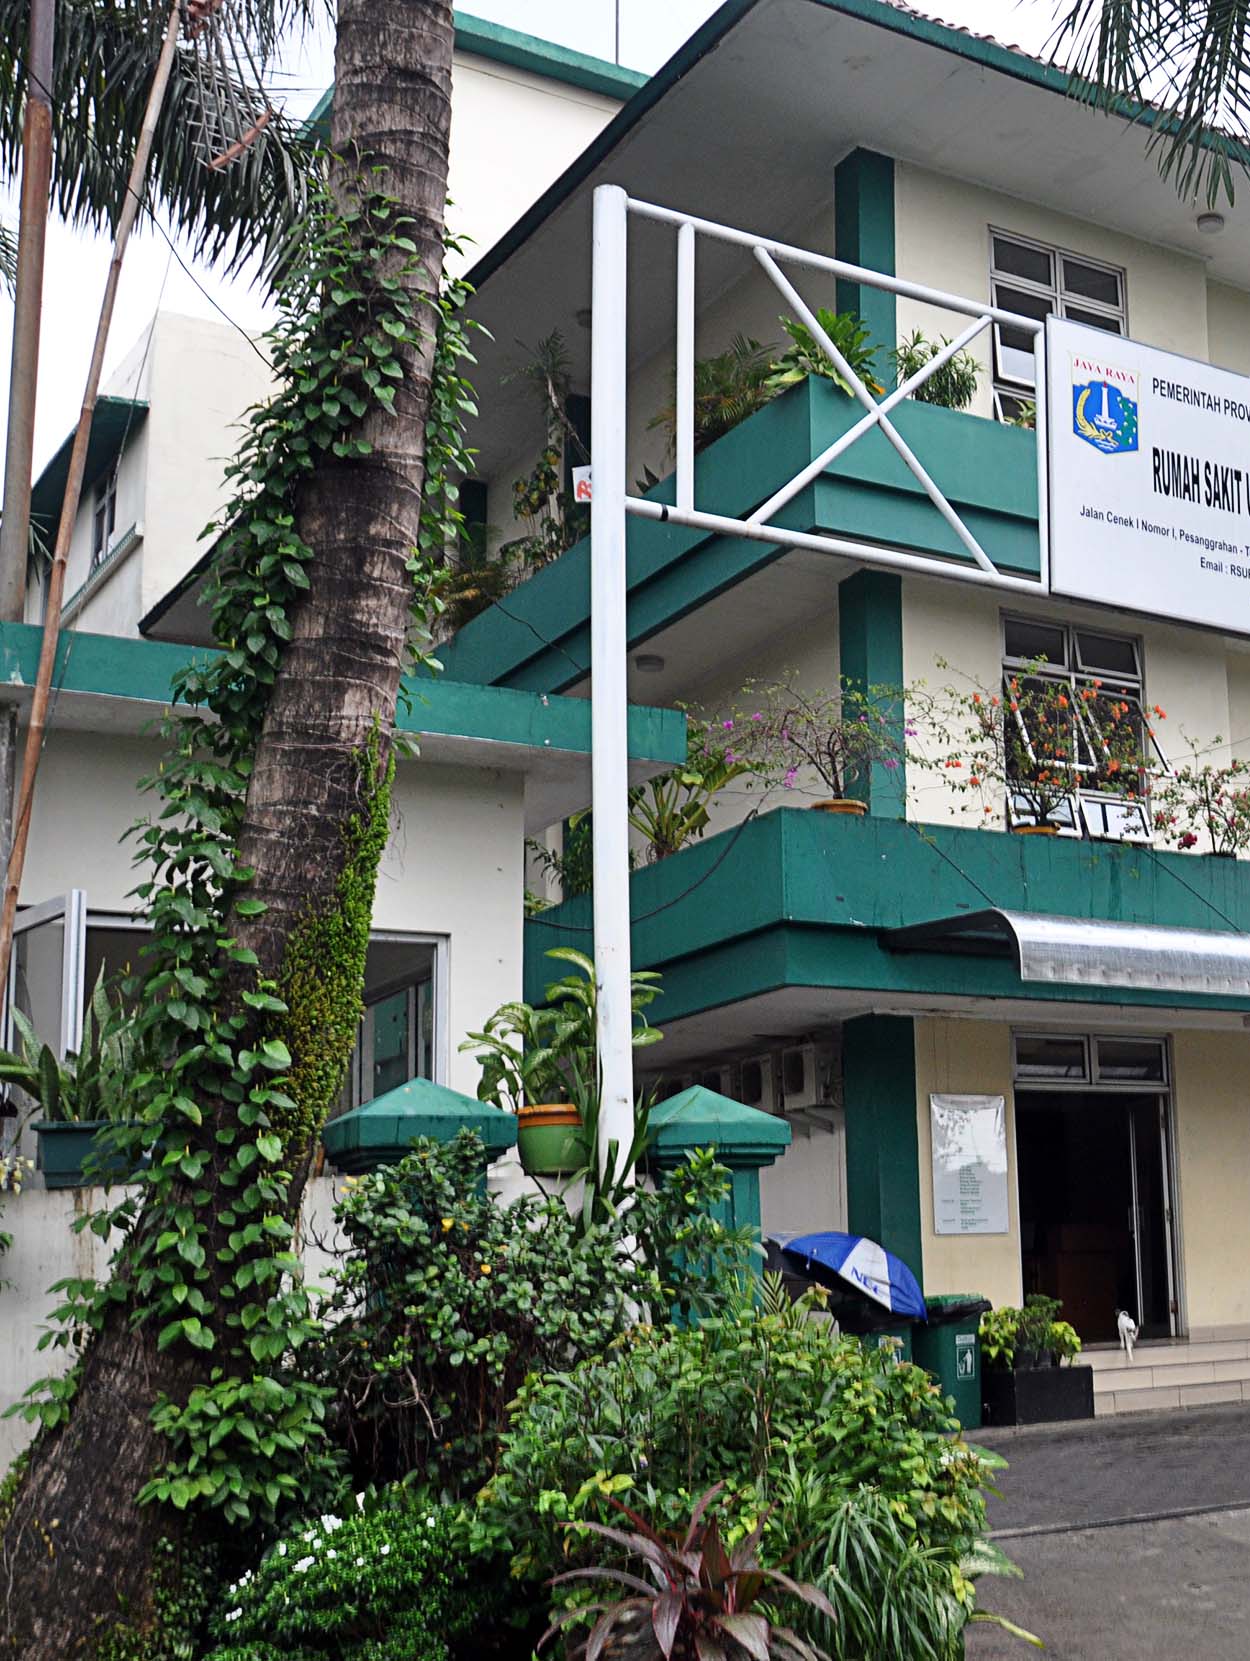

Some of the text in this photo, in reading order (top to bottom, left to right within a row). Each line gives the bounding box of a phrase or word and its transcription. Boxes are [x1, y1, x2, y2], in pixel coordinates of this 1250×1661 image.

[1073, 358, 1135, 384] JAYA RAYA
[1153, 377, 1221, 413] PEMERINTAH
[1153, 447, 1200, 504] RUMAH
[1204, 460, 1242, 515] SAKIT
[1080, 504, 1104, 521] Jalan
[1106, 511, 1134, 529] Cenek
[1141, 520, 1170, 538] Nomor
[1179, 529, 1238, 555] Pesanggrahan
[1200, 557, 1223, 573] Email
